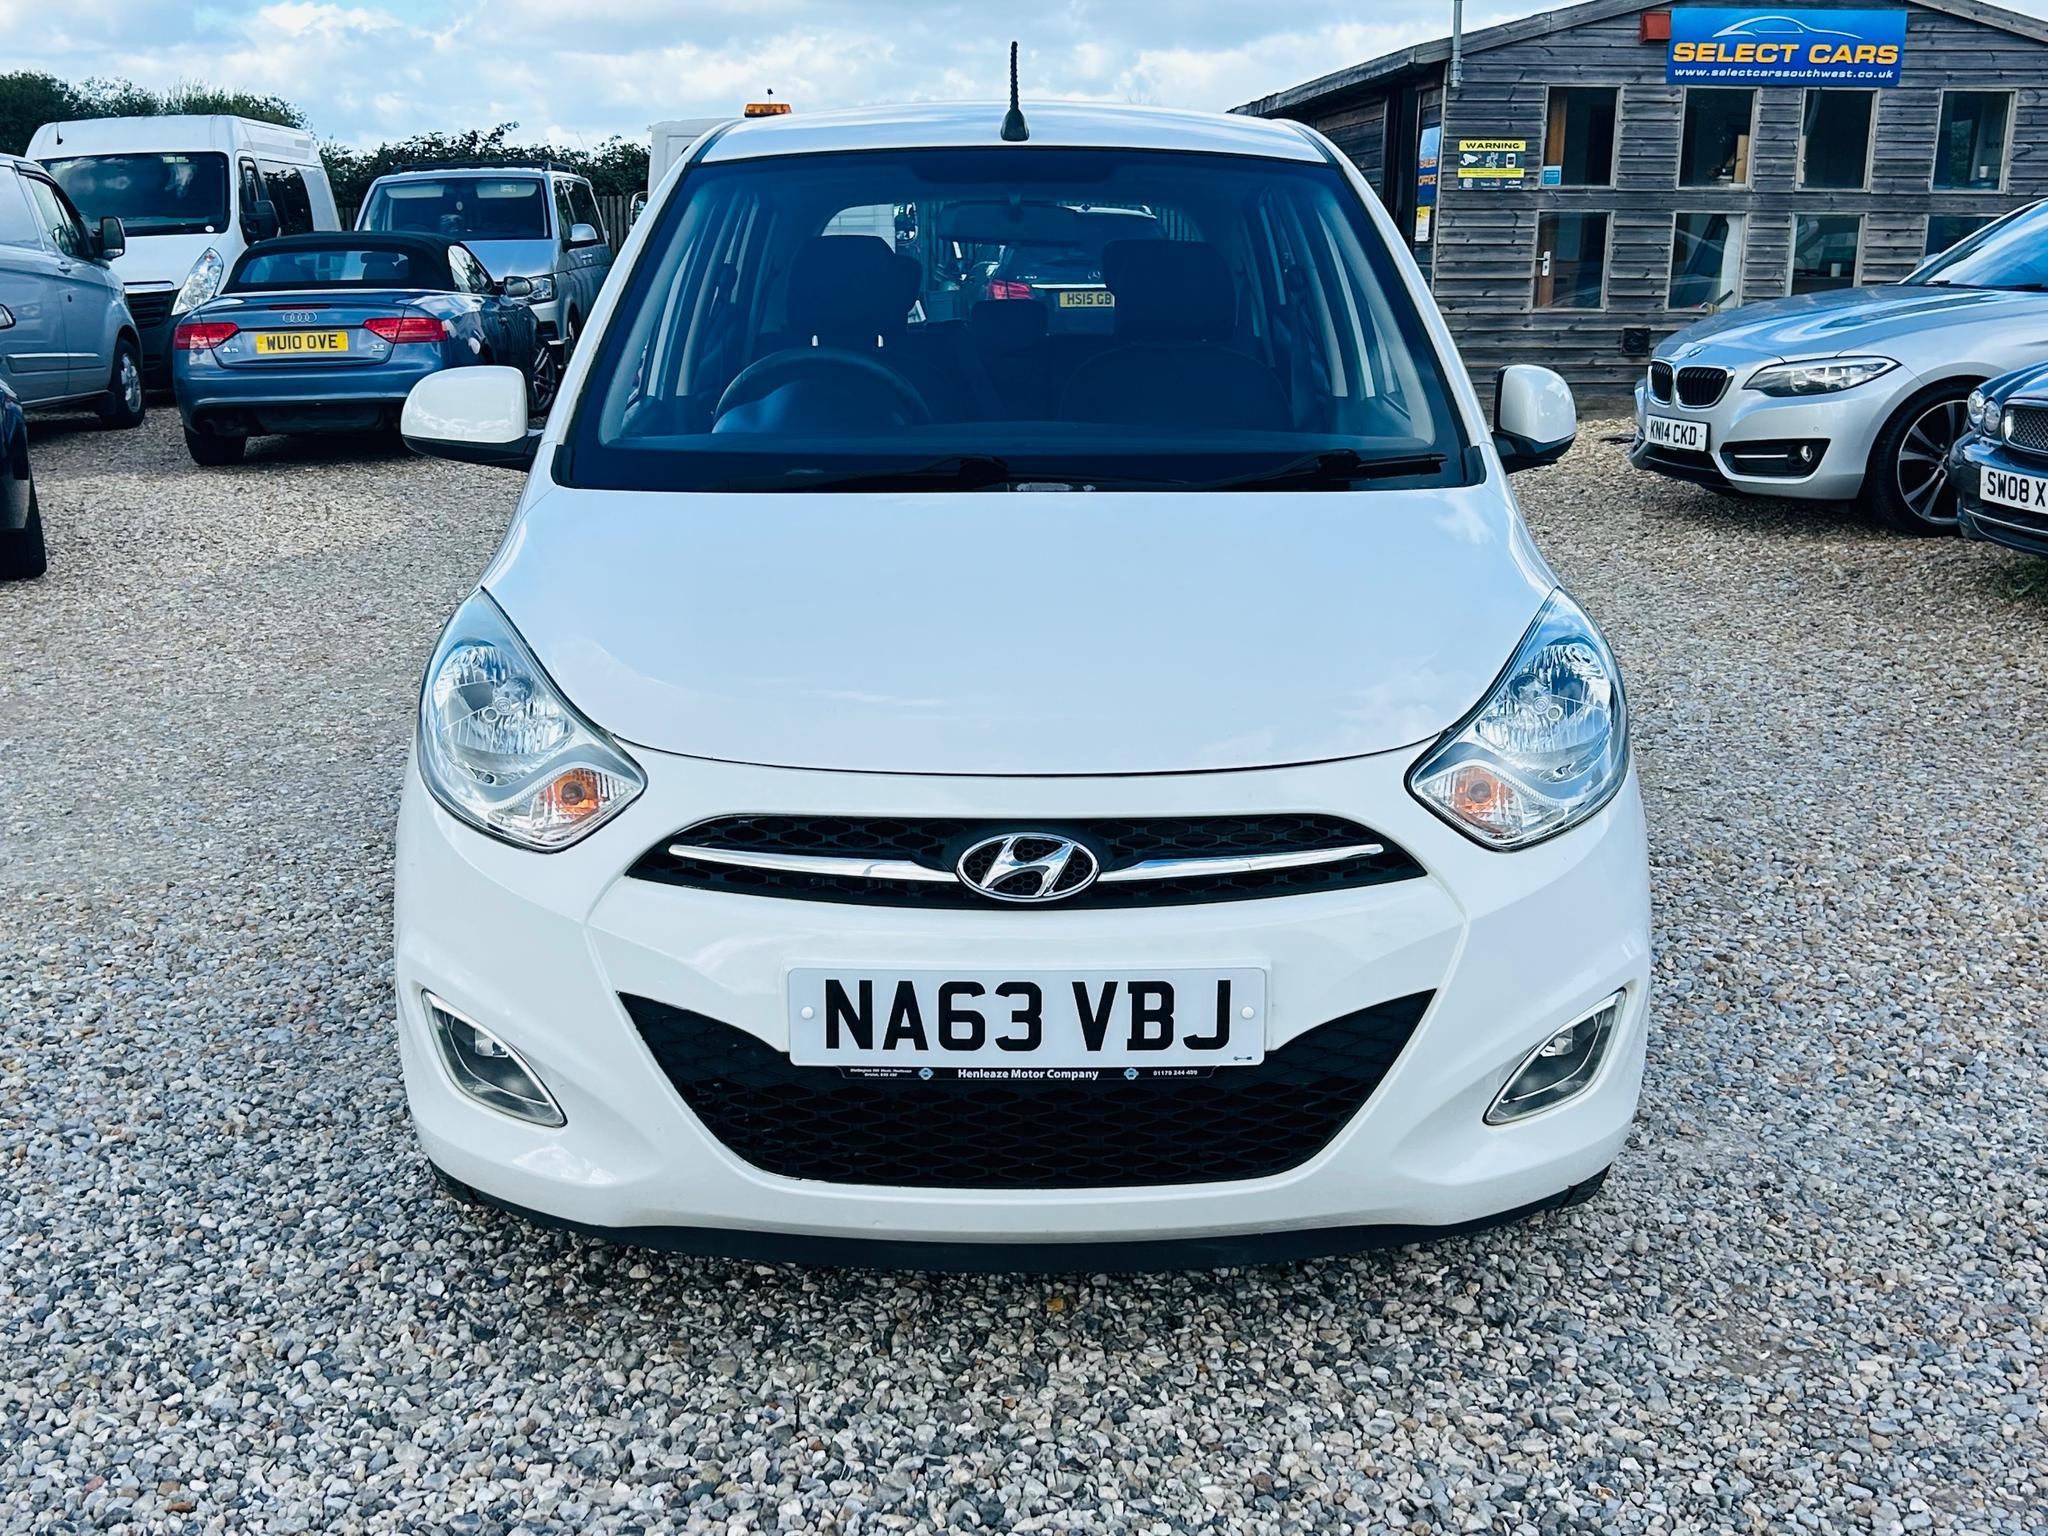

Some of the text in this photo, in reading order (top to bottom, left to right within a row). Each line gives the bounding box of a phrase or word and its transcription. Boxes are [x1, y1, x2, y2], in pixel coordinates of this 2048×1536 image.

[1672, 42, 1899, 65] SELECT CARS
[1674, 67, 1894, 79] www.selectcarssouthwest.co.uk
[1066, 293, 1094, 305] HS15
[266, 334, 338, 350] WU10 OVE
[1650, 420, 1697, 446] KN14 CKD
[1987, 471, 2047, 507] SW08 X
[824, 978, 1232, 1052] NA63 VBJ
[957, 1068, 1099, 1081] Henleaze Motor Company
